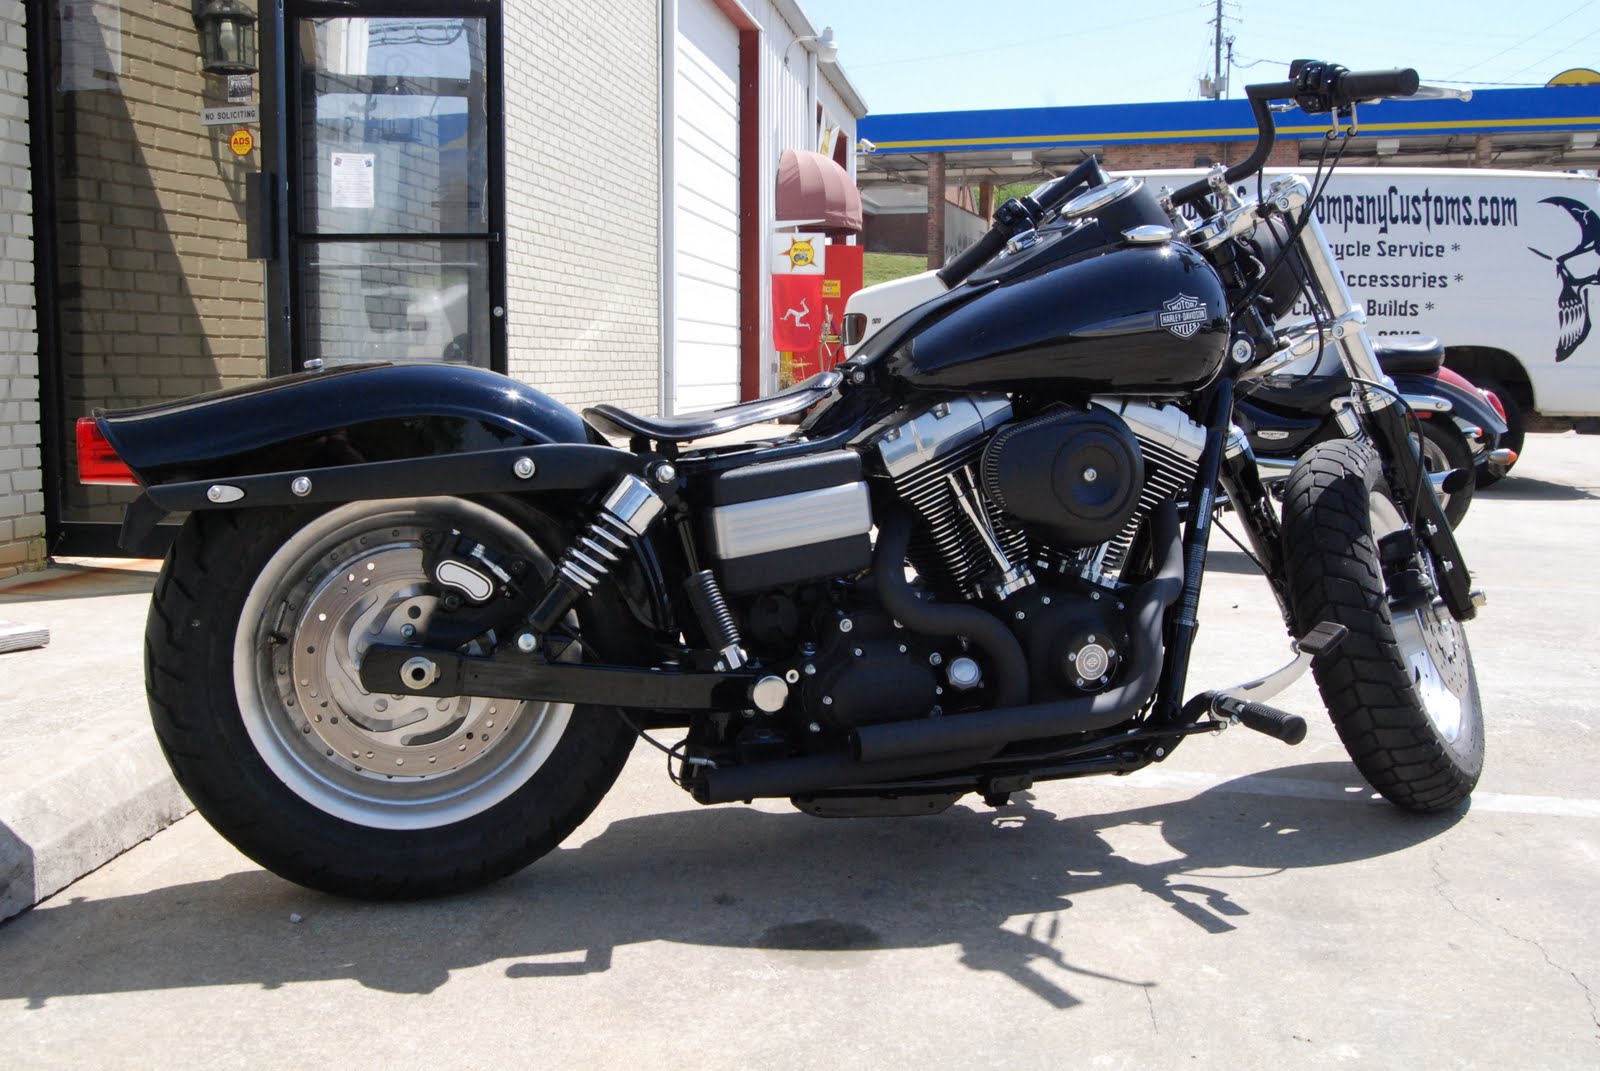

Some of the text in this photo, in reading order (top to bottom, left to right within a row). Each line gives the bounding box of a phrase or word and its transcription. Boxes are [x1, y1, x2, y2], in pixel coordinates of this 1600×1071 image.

[205, 110, 256, 120] NO SOLICITING
[233, 137, 250, 145] ADS
[1306, 185, 1518, 234] ompanyCustoms.com
[1376, 240, 1445, 258] Service
[1171, 300, 1195, 311] MOTOR
[1366, 299, 1419, 317] Builds
[1173, 322, 1197, 335] CYCLES
